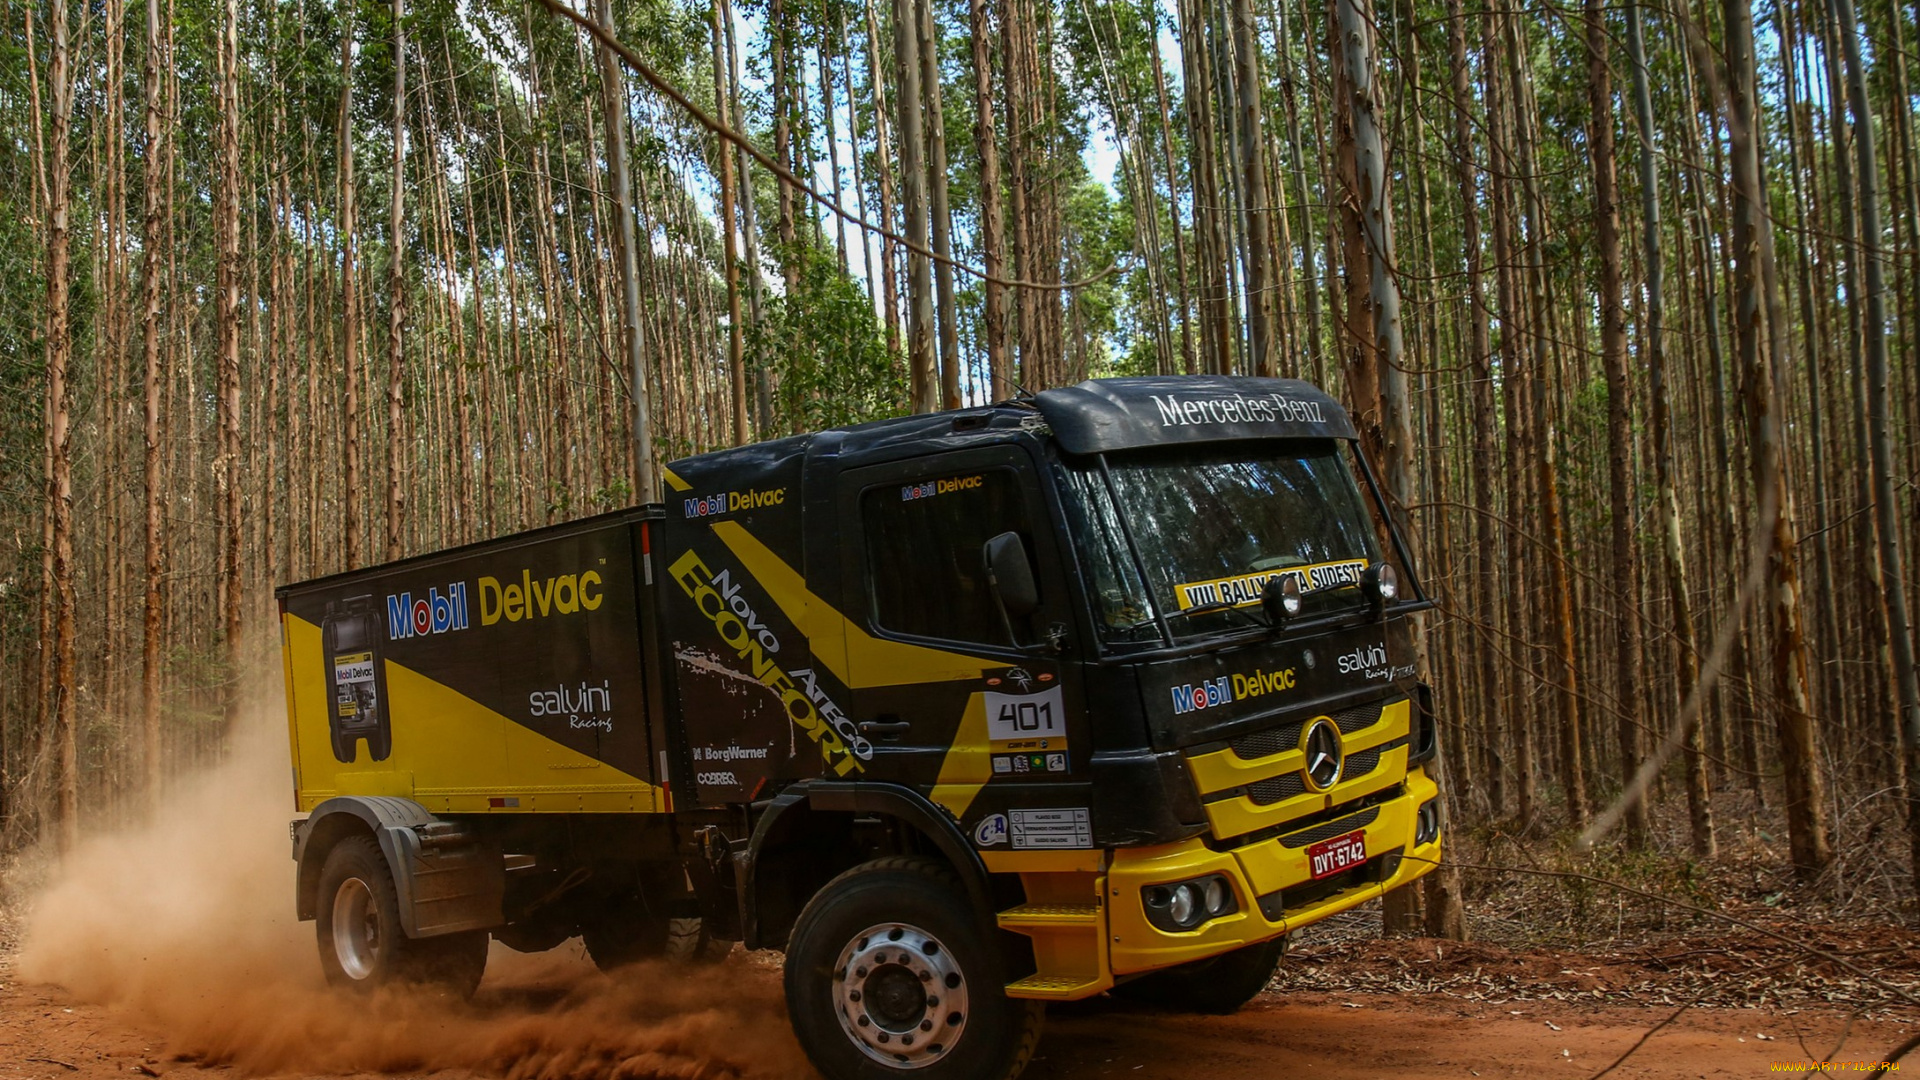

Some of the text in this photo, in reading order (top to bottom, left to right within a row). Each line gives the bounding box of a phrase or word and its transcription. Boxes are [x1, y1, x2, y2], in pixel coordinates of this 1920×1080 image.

[1150, 394, 1326, 426] Mercedes-Benz
[684, 488, 784, 518] Mobil Delvac
[902, 475, 982, 501] Mobil Delvac
[1219, 576, 1266, 605] RALLY
[1310, 563, 1363, 589] SUDESTE
[387, 581, 469, 640] Mobil
[478, 569, 603, 626] Delvac
[1338, 641, 1386, 673] salvini
[337, 667, 372, 680] Mobil Delvac
[530, 680, 611, 716] salvini
[1171, 667, 1296, 714] Mobil Delvac
[570, 715, 612, 731] Racing
[998, 702, 1053, 731] 401
[705, 746, 767, 762] BorgWarner
